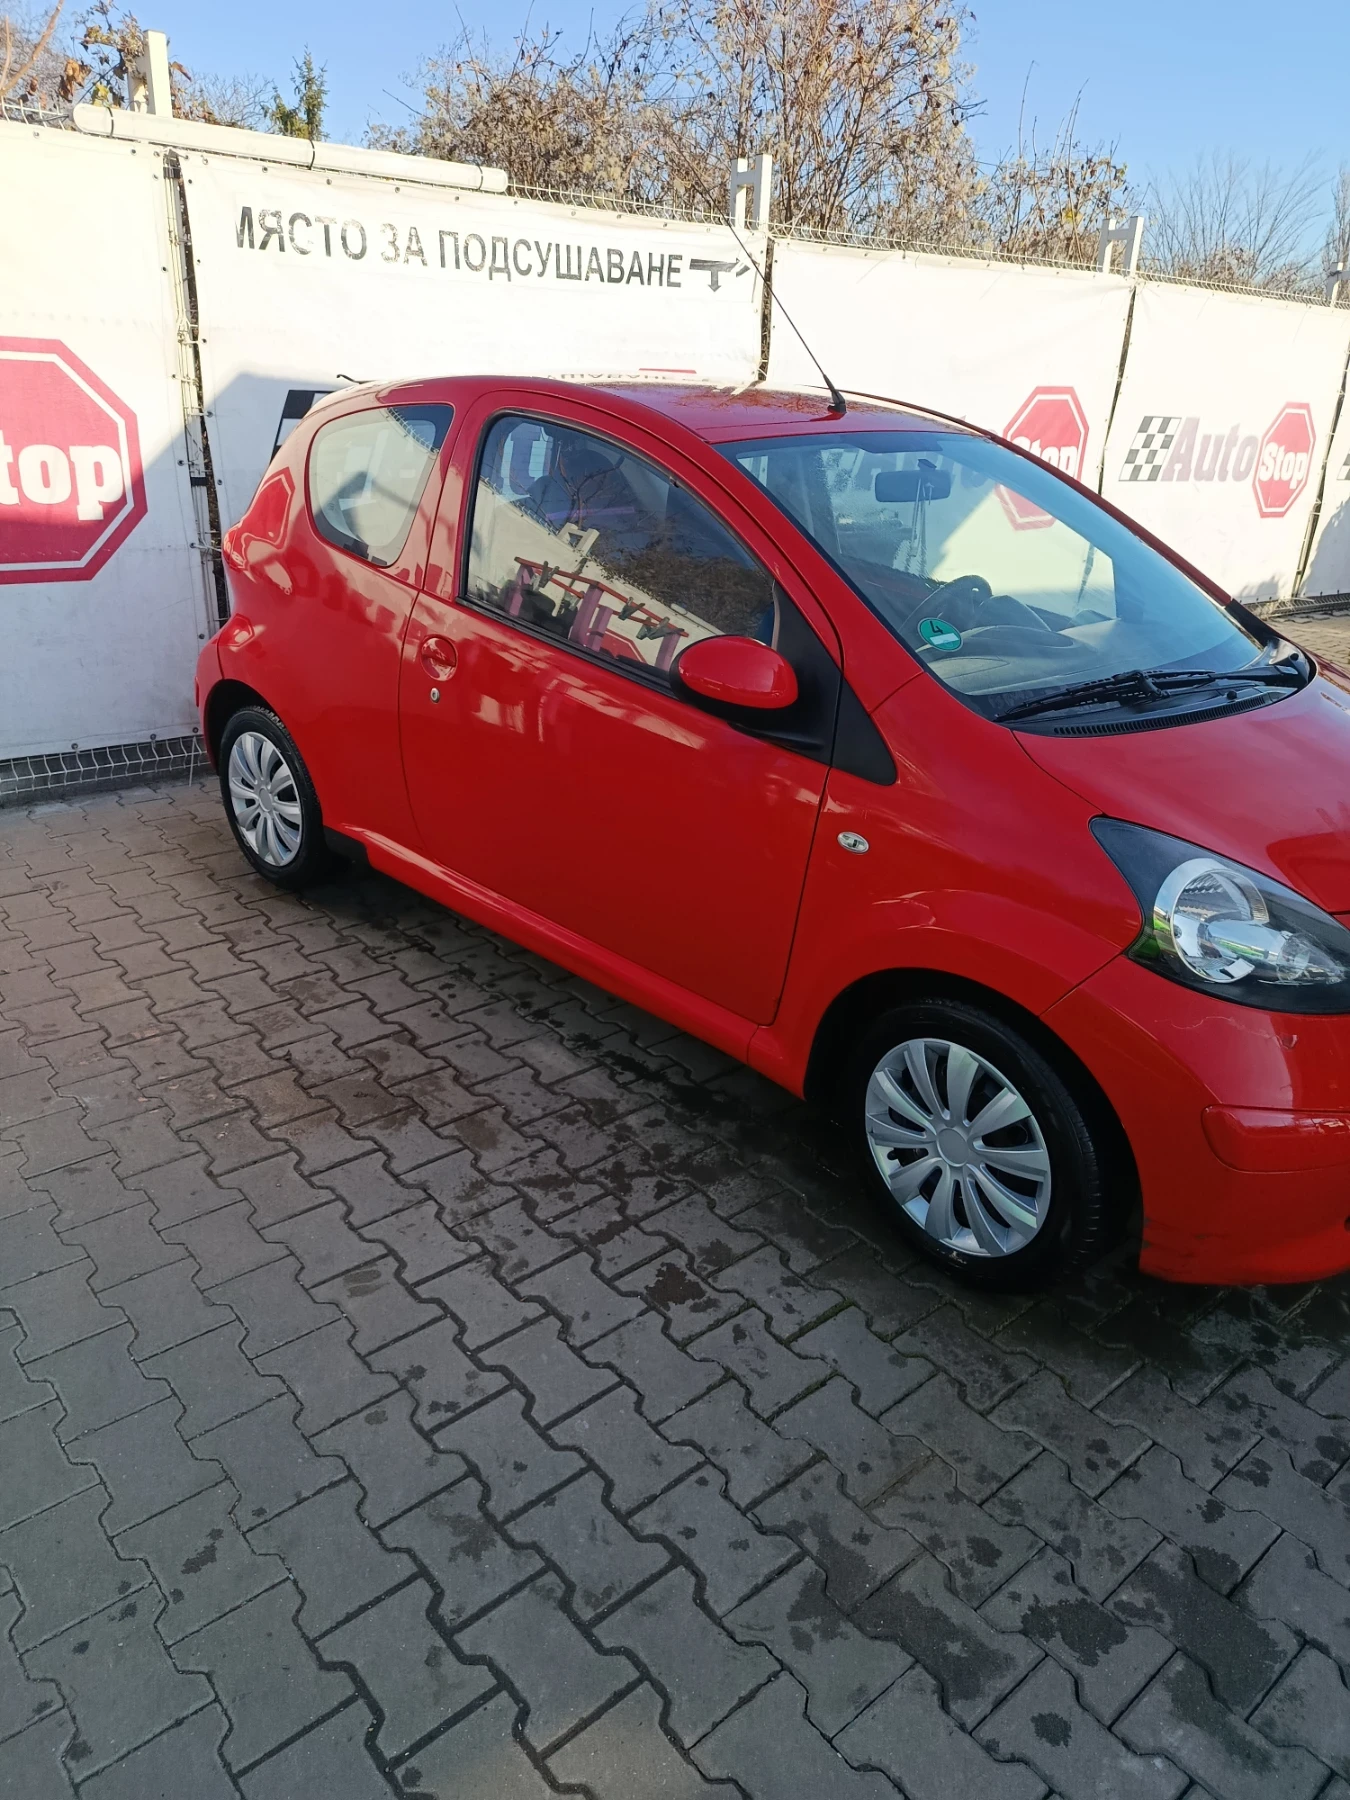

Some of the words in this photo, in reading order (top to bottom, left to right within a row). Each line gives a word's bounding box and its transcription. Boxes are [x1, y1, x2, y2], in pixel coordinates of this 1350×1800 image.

[235, 206, 367, 260] МЯСТО
[380, 222, 428, 267] ЗА
[438, 229, 683, 289] ПОДСУШАВАНЕ
[1160, 416, 1260, 483] Auto
[1258, 442, 1308, 490] Stop
[929, 620, 944, 635] 4
